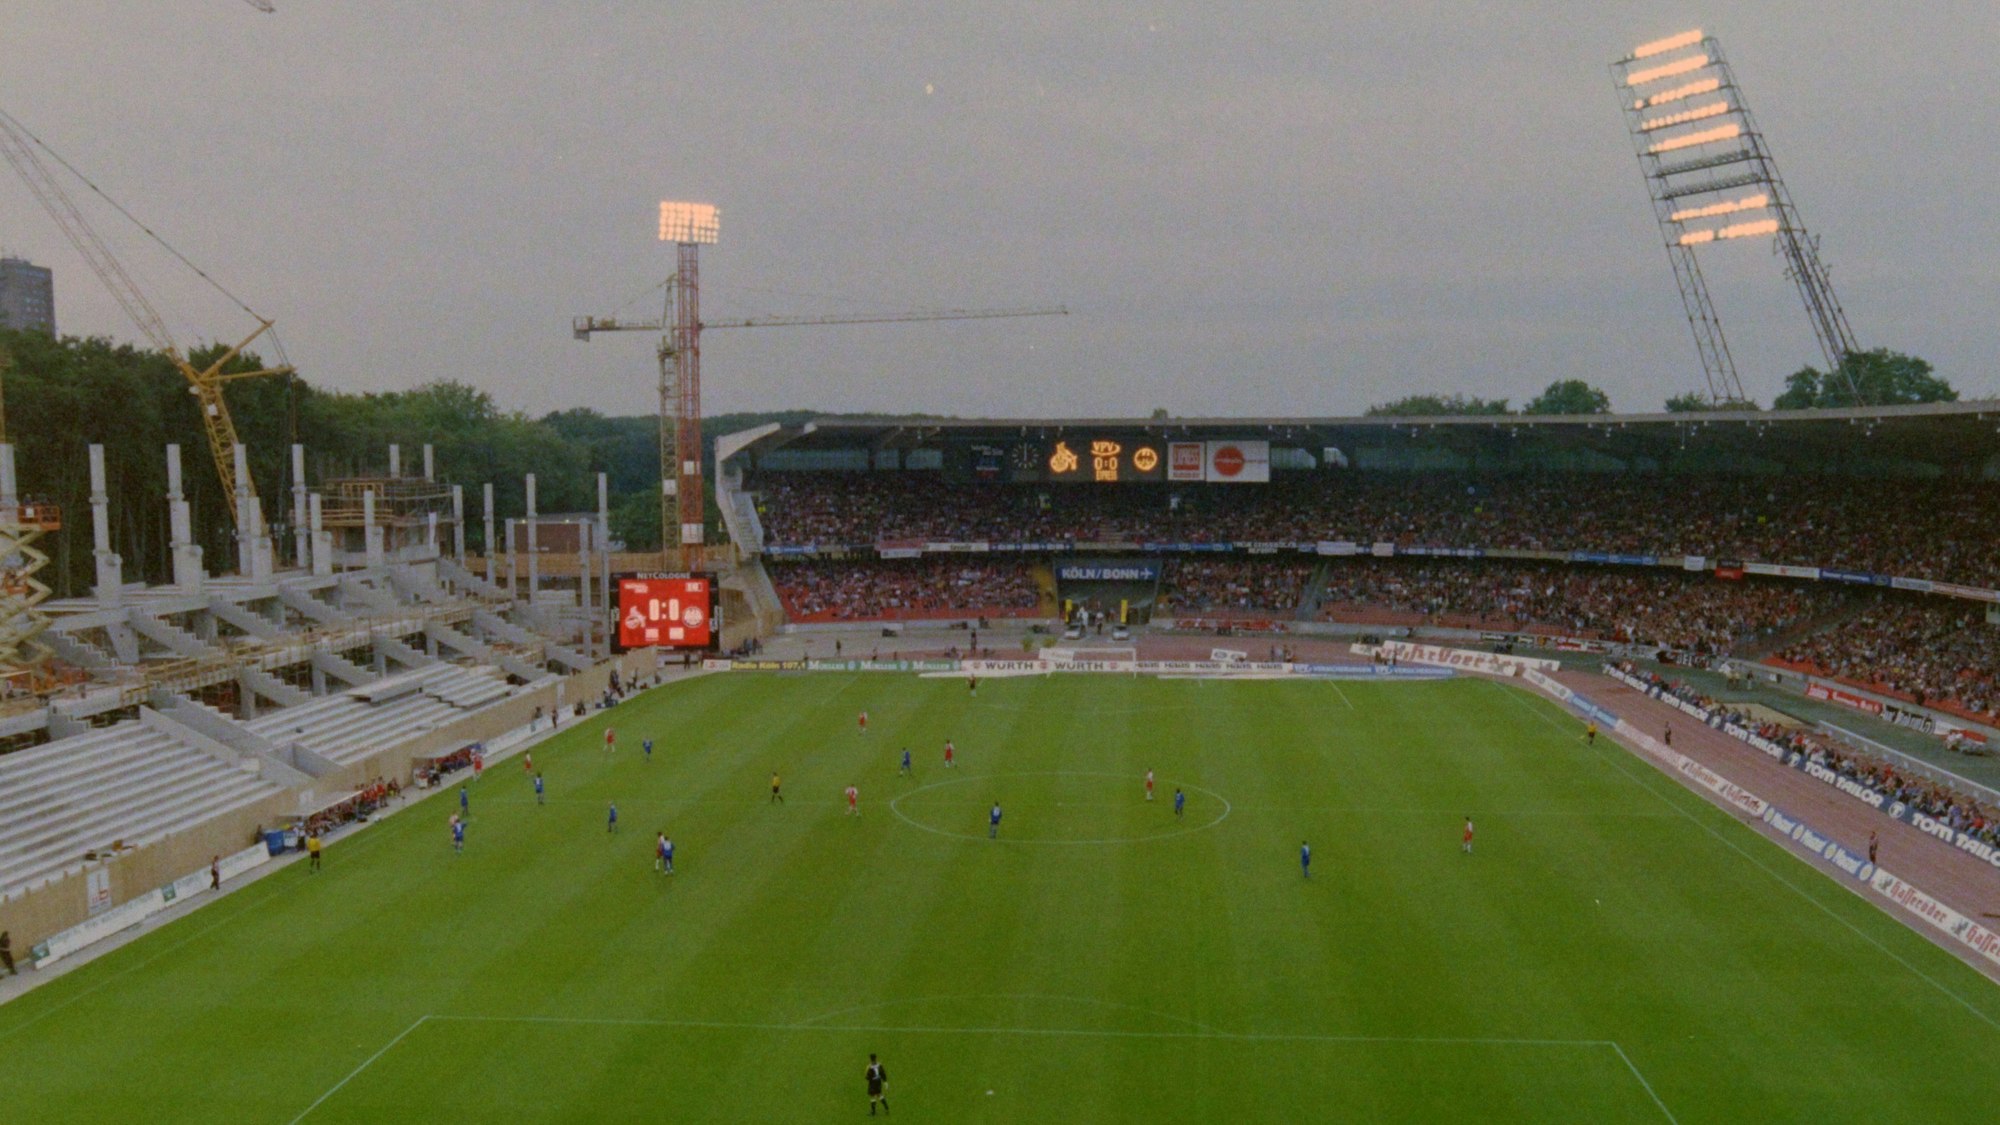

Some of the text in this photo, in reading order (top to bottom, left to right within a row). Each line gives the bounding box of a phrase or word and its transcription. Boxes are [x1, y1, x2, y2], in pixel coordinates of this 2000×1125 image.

[1723, 722, 1749, 741] TOM
[1805, 761, 1884, 809] TOM TAILOR
[1912, 812, 1954, 843] TOM
